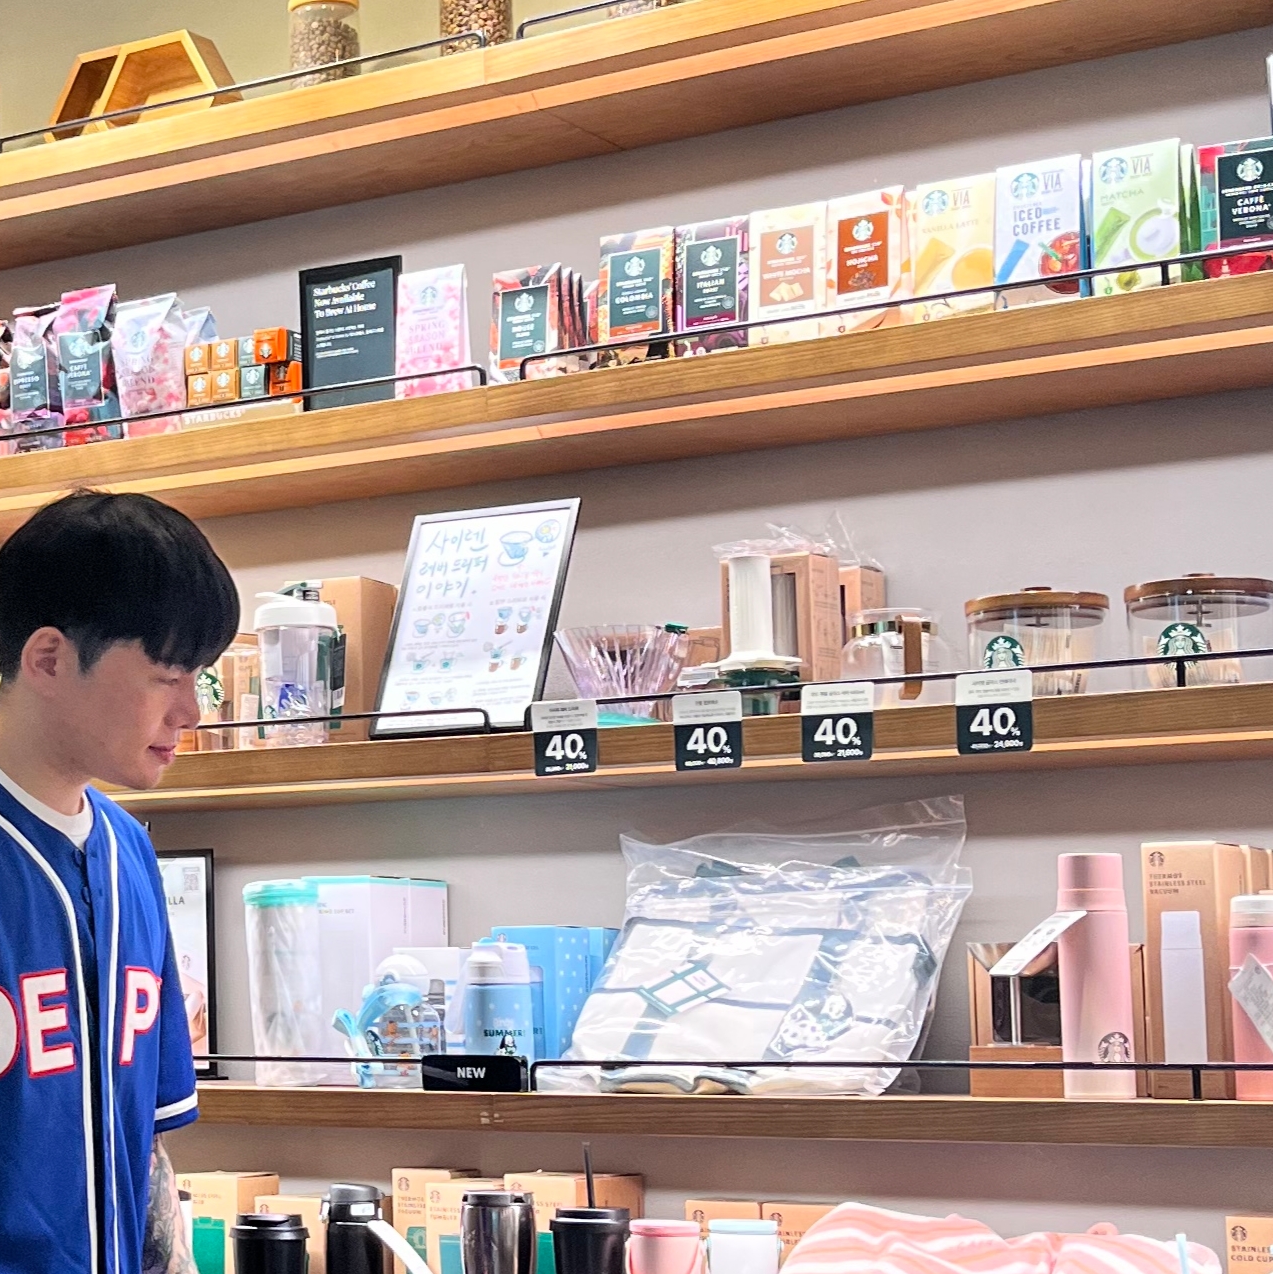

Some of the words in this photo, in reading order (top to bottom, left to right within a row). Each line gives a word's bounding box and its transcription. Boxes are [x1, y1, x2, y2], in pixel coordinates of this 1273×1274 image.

[1012, 218, 1061, 237] COFFEE
[1013, 207, 1042, 223] ICED
[426, 527, 489, 553] 사이렌
[813, 717, 862, 745] 40%
[969, 707, 1021, 736] 40%
[545, 733, 588, 760] 40%
[686, 726, 732, 754] 40%
[456, 1066, 486, 1079] NEW
[1231, 1245, 1271, 1253] STAINLES
